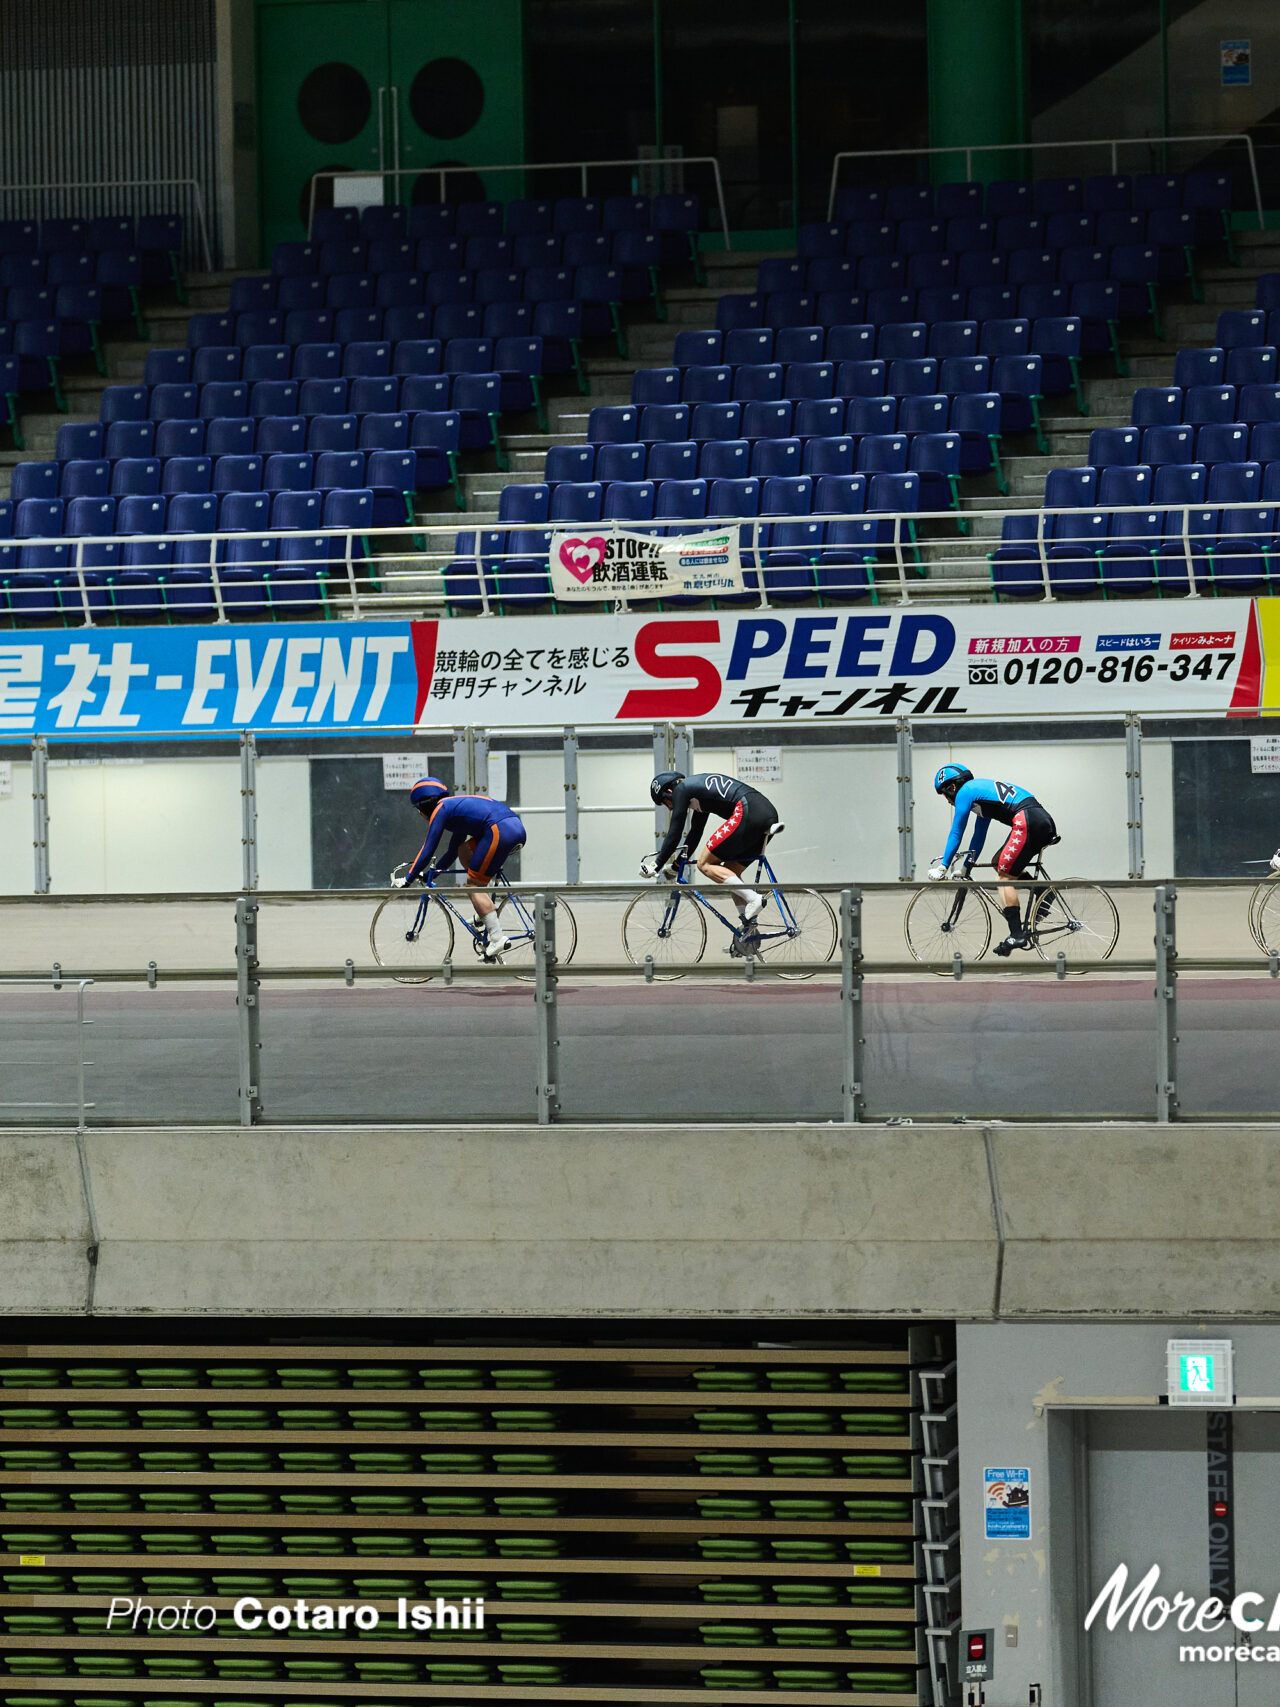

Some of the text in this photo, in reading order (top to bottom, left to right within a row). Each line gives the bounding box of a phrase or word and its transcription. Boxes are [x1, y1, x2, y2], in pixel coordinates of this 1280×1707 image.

[604, 538, 664, 559] STOP!!
[592, 561, 668, 583] 飲酒運転
[974, 638, 1070, 653] 新規加入の方
[435, 646, 630, 673] 競輪の全てを感じる
[615, 614, 956, 719] SPEED
[1003, 653, 1236, 686] 0120-816-347
[429, 675, 587, 701] 専門チャンネル
[730, 683, 968, 718] チャンネル
[705, 774, 733, 798] 2
[937, 769, 946, 783] 4
[994, 781, 1018, 804] 4
[987, 1470, 1026, 1478] Free Wi-Fi
[1207, 1412, 1229, 1595] STAFF ONLY
